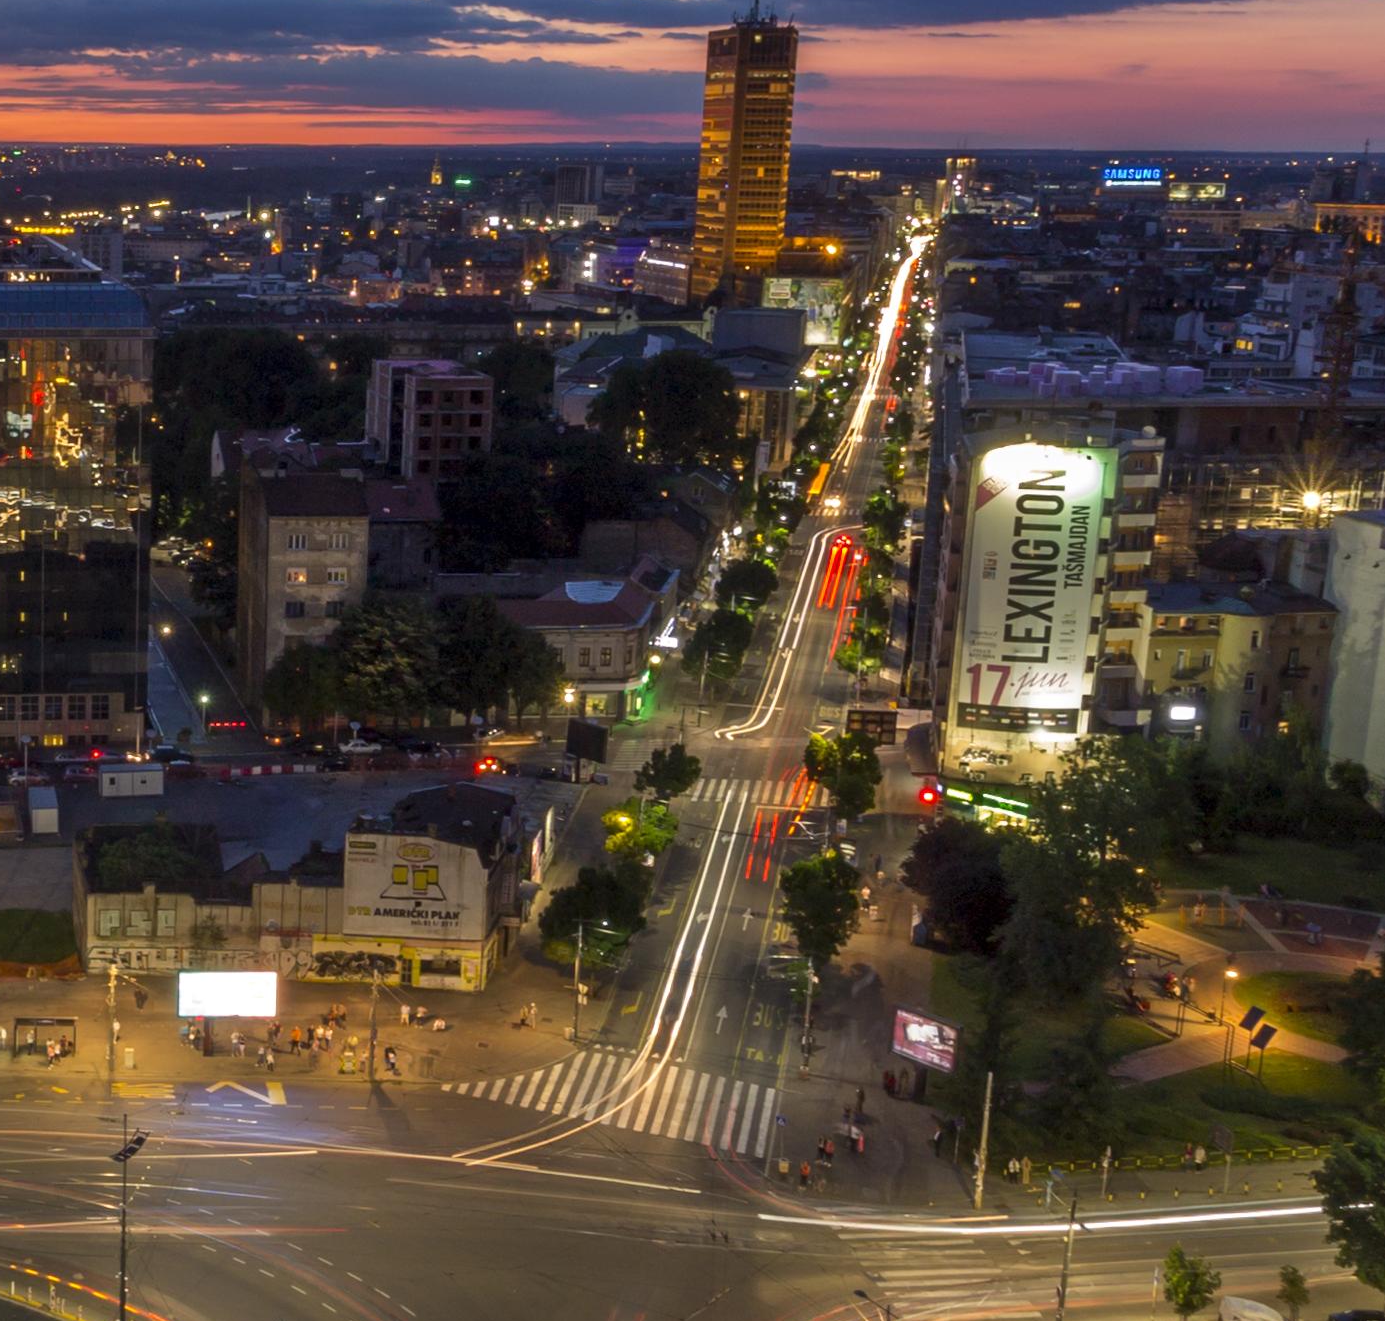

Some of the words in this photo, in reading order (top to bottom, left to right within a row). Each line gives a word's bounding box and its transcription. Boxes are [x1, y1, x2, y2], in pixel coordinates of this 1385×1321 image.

[1104, 168, 1161, 179] SAMSUNG
[1001, 470, 1066, 663] LEXINGTON
[1062, 506, 1090, 589] TAŠMAJDAN
[1014, 666, 1069, 699] jun
